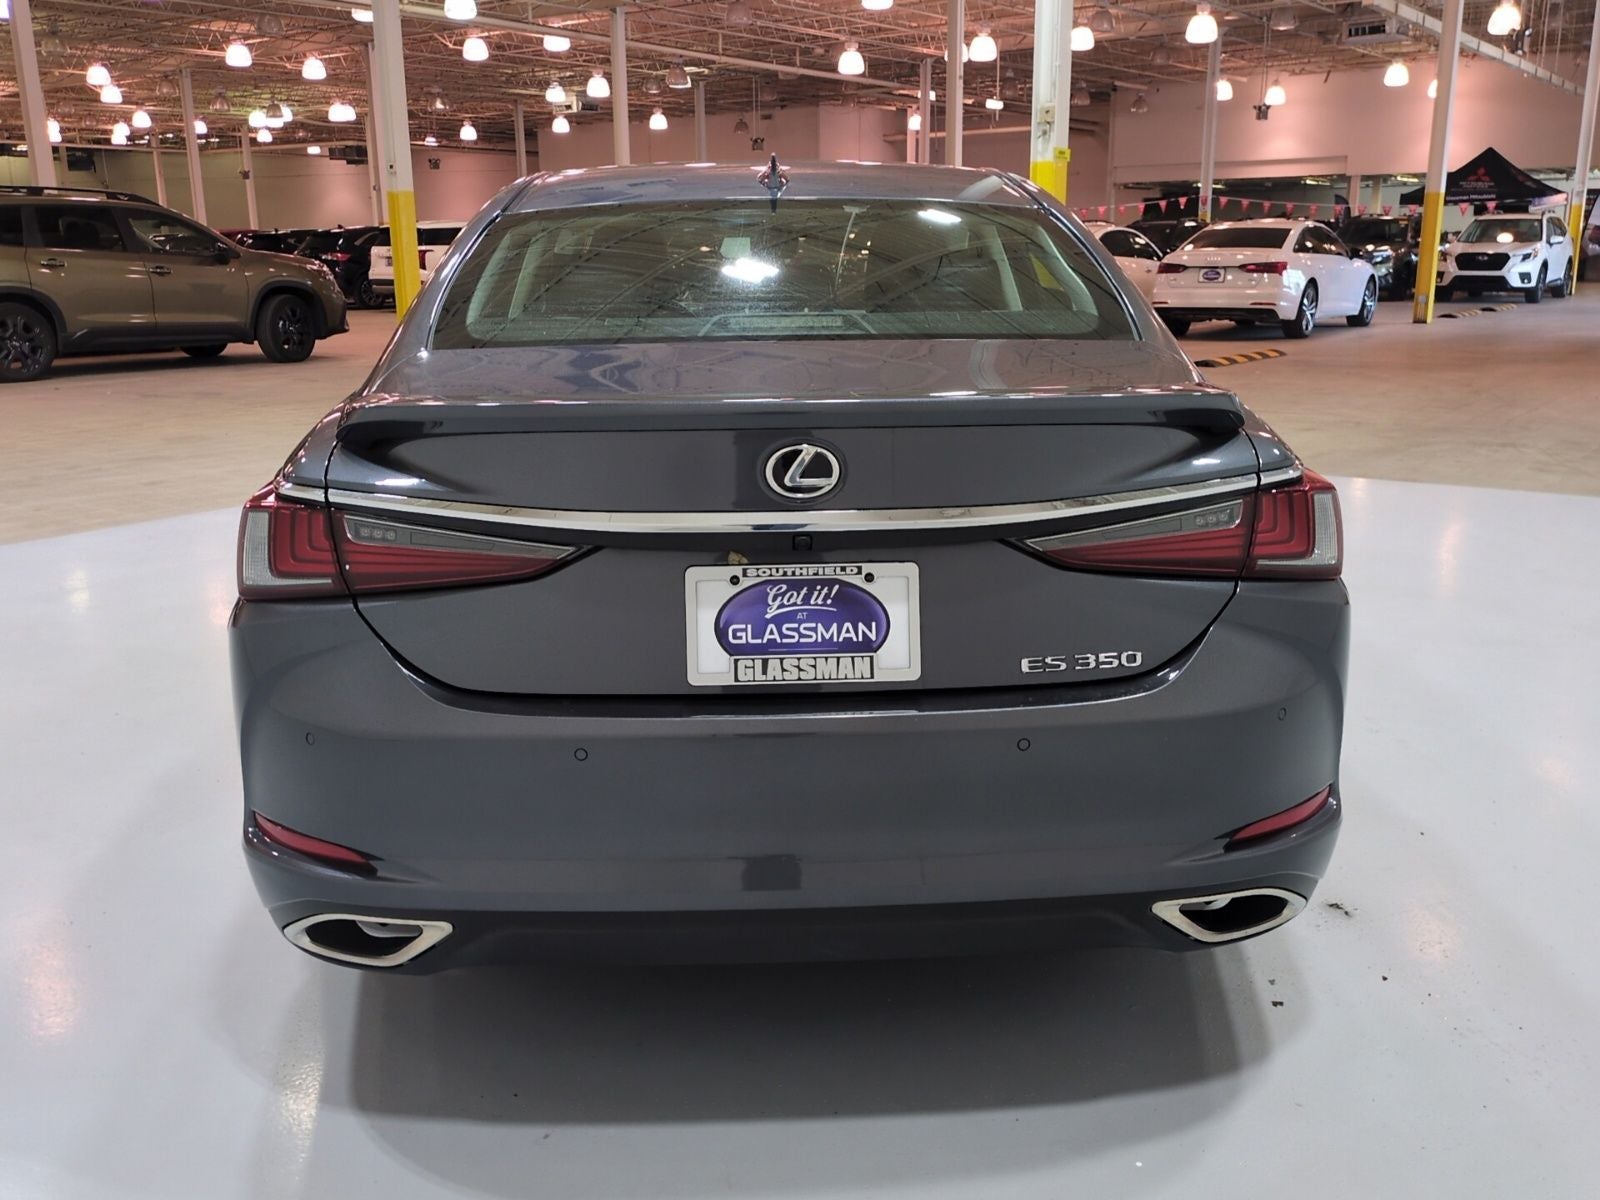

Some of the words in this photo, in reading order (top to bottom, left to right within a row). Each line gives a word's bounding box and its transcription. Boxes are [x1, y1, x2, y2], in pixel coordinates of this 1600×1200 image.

[746, 566, 858, 577] SOUTHFIELD
[766, 584, 808, 613] Got
[810, 584, 840, 605] it!
[797, 612, 808, 620] AT
[728, 621, 877, 644] GLASSMAN
[737, 656, 872, 682] GLASSMAN
[1020, 655, 1067, 673] ES
[1074, 650, 1142, 670] 350
